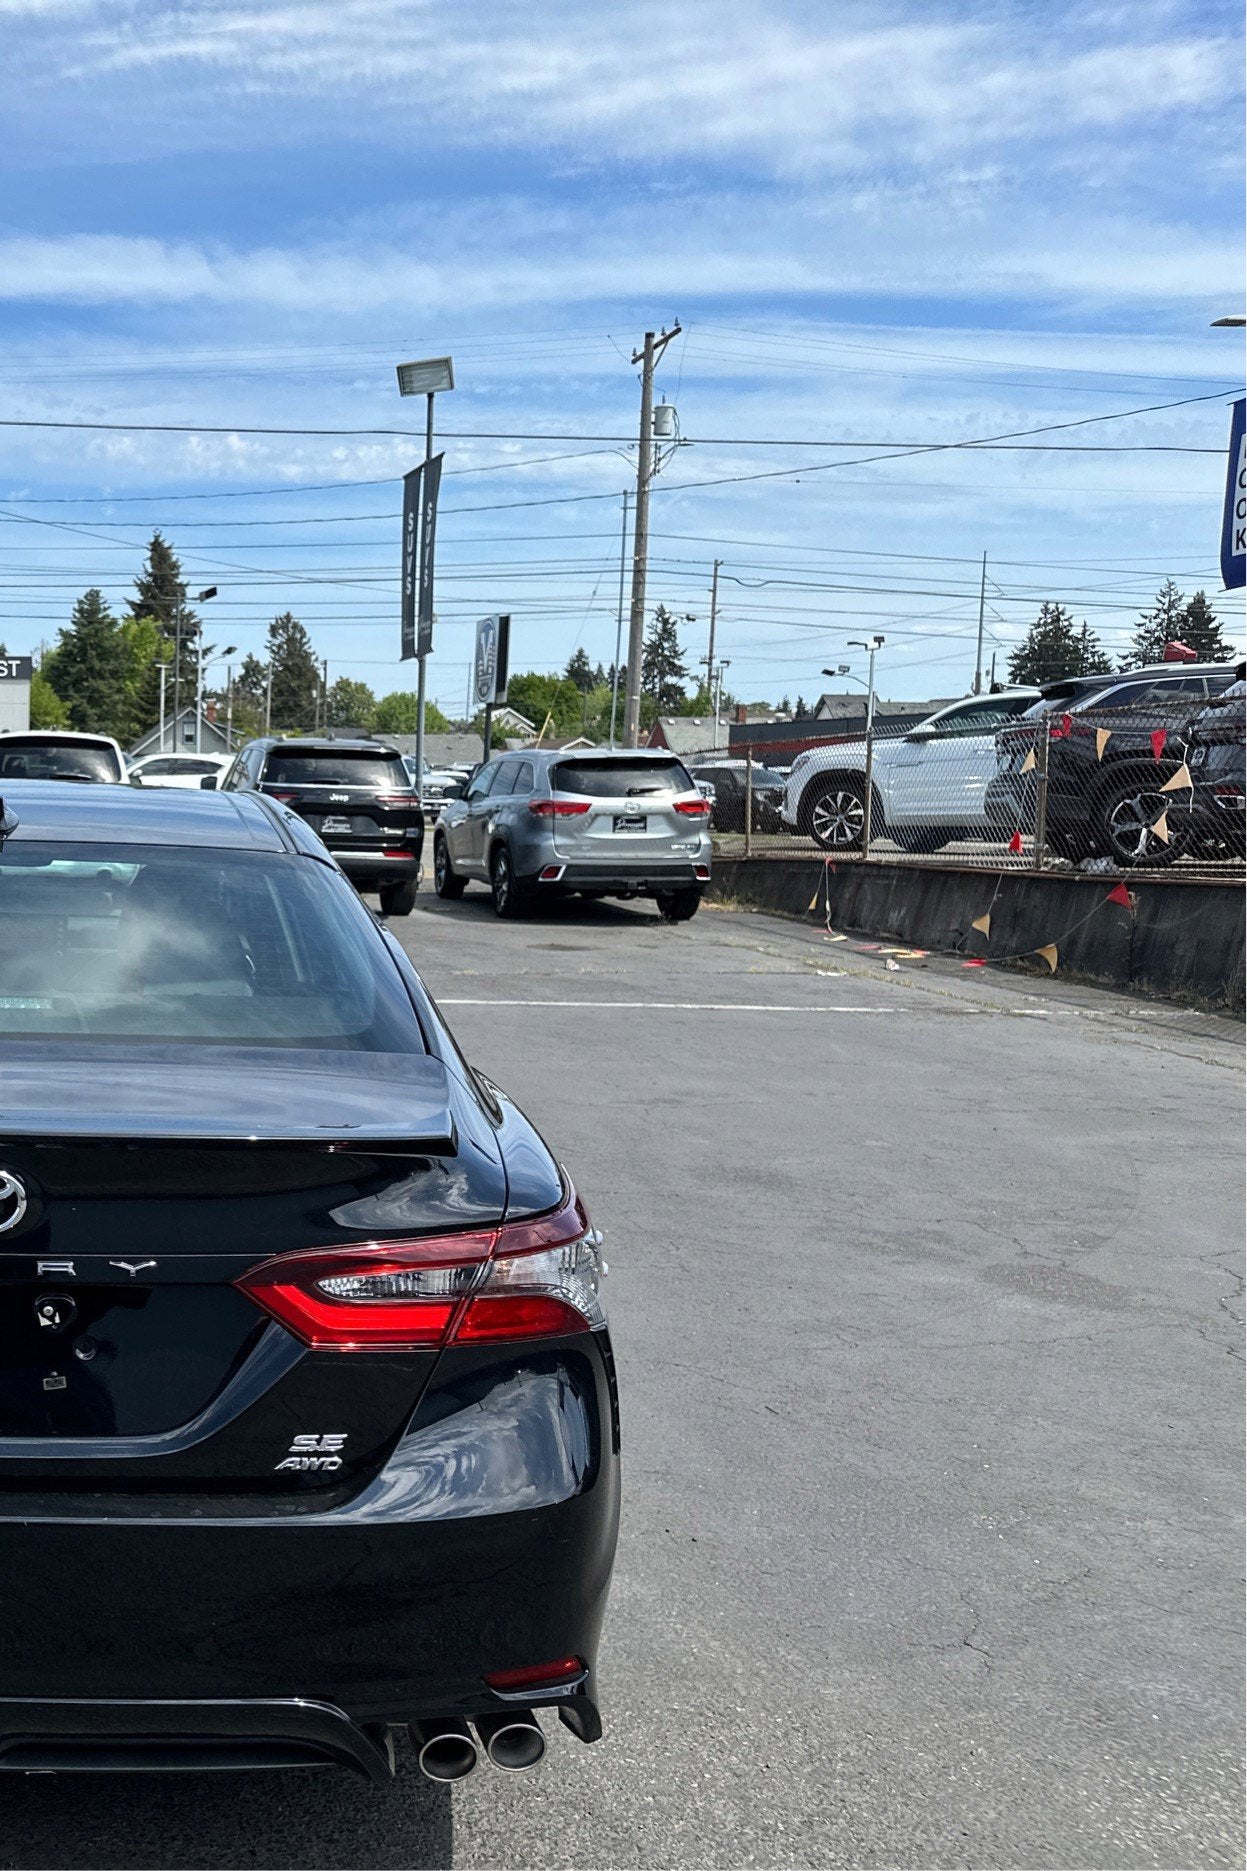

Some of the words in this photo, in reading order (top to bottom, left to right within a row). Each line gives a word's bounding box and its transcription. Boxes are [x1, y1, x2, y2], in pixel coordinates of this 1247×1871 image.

[329, 793, 350, 802] Jeep
[288, 1433, 349, 1452] SE
[273, 1456, 343, 1471] AWD
